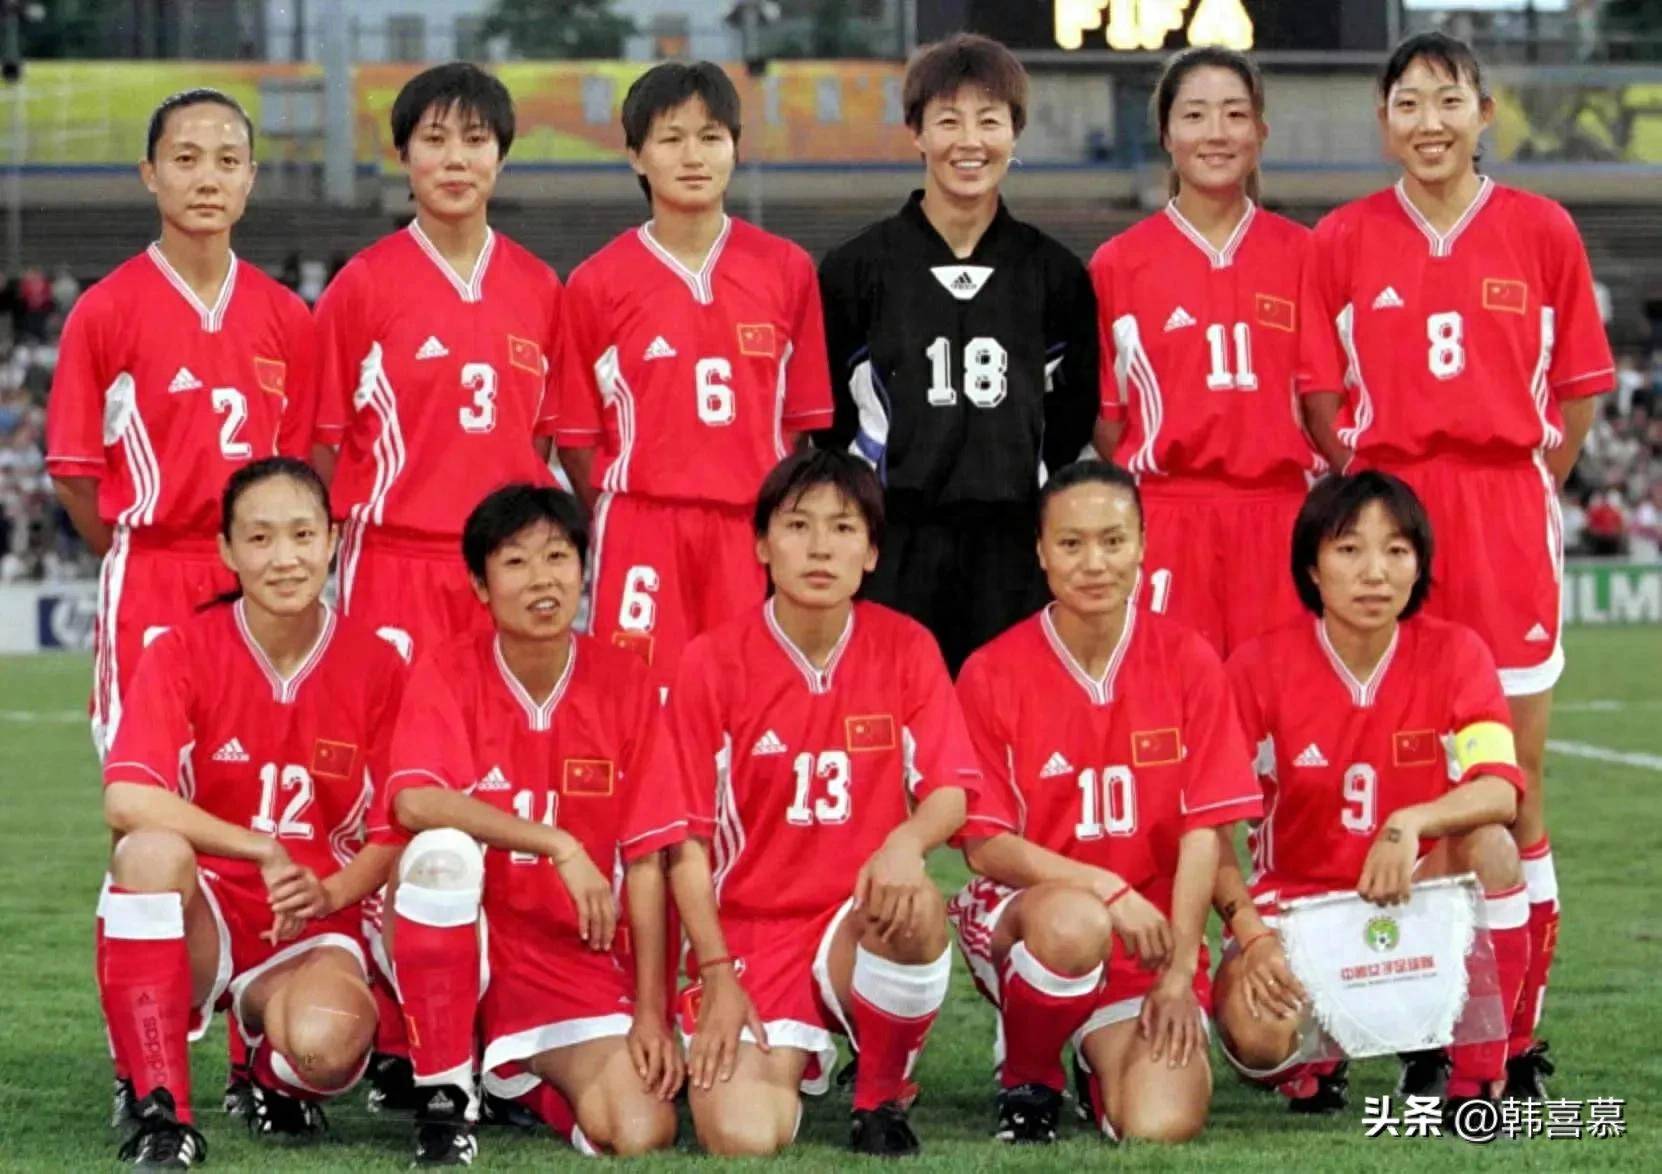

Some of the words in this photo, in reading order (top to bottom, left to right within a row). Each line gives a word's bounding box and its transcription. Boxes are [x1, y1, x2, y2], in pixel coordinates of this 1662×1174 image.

[1054, 0, 1254, 50] FIFA
[926, 336, 1008, 408] 18
[1206, 322, 1259, 392] 11
[1427, 310, 1466, 381] 8
[211, 387, 252, 460] 2
[459, 362, 498, 434] 3
[695, 357, 737, 428] 6
[618, 565, 660, 634] 6
[251, 762, 315, 840] 12
[786, 750, 852, 826] 13
[1075, 765, 1137, 841] 10
[1341, 762, 1377, 837] 9
[142, 1015, 168, 1085] adidas
